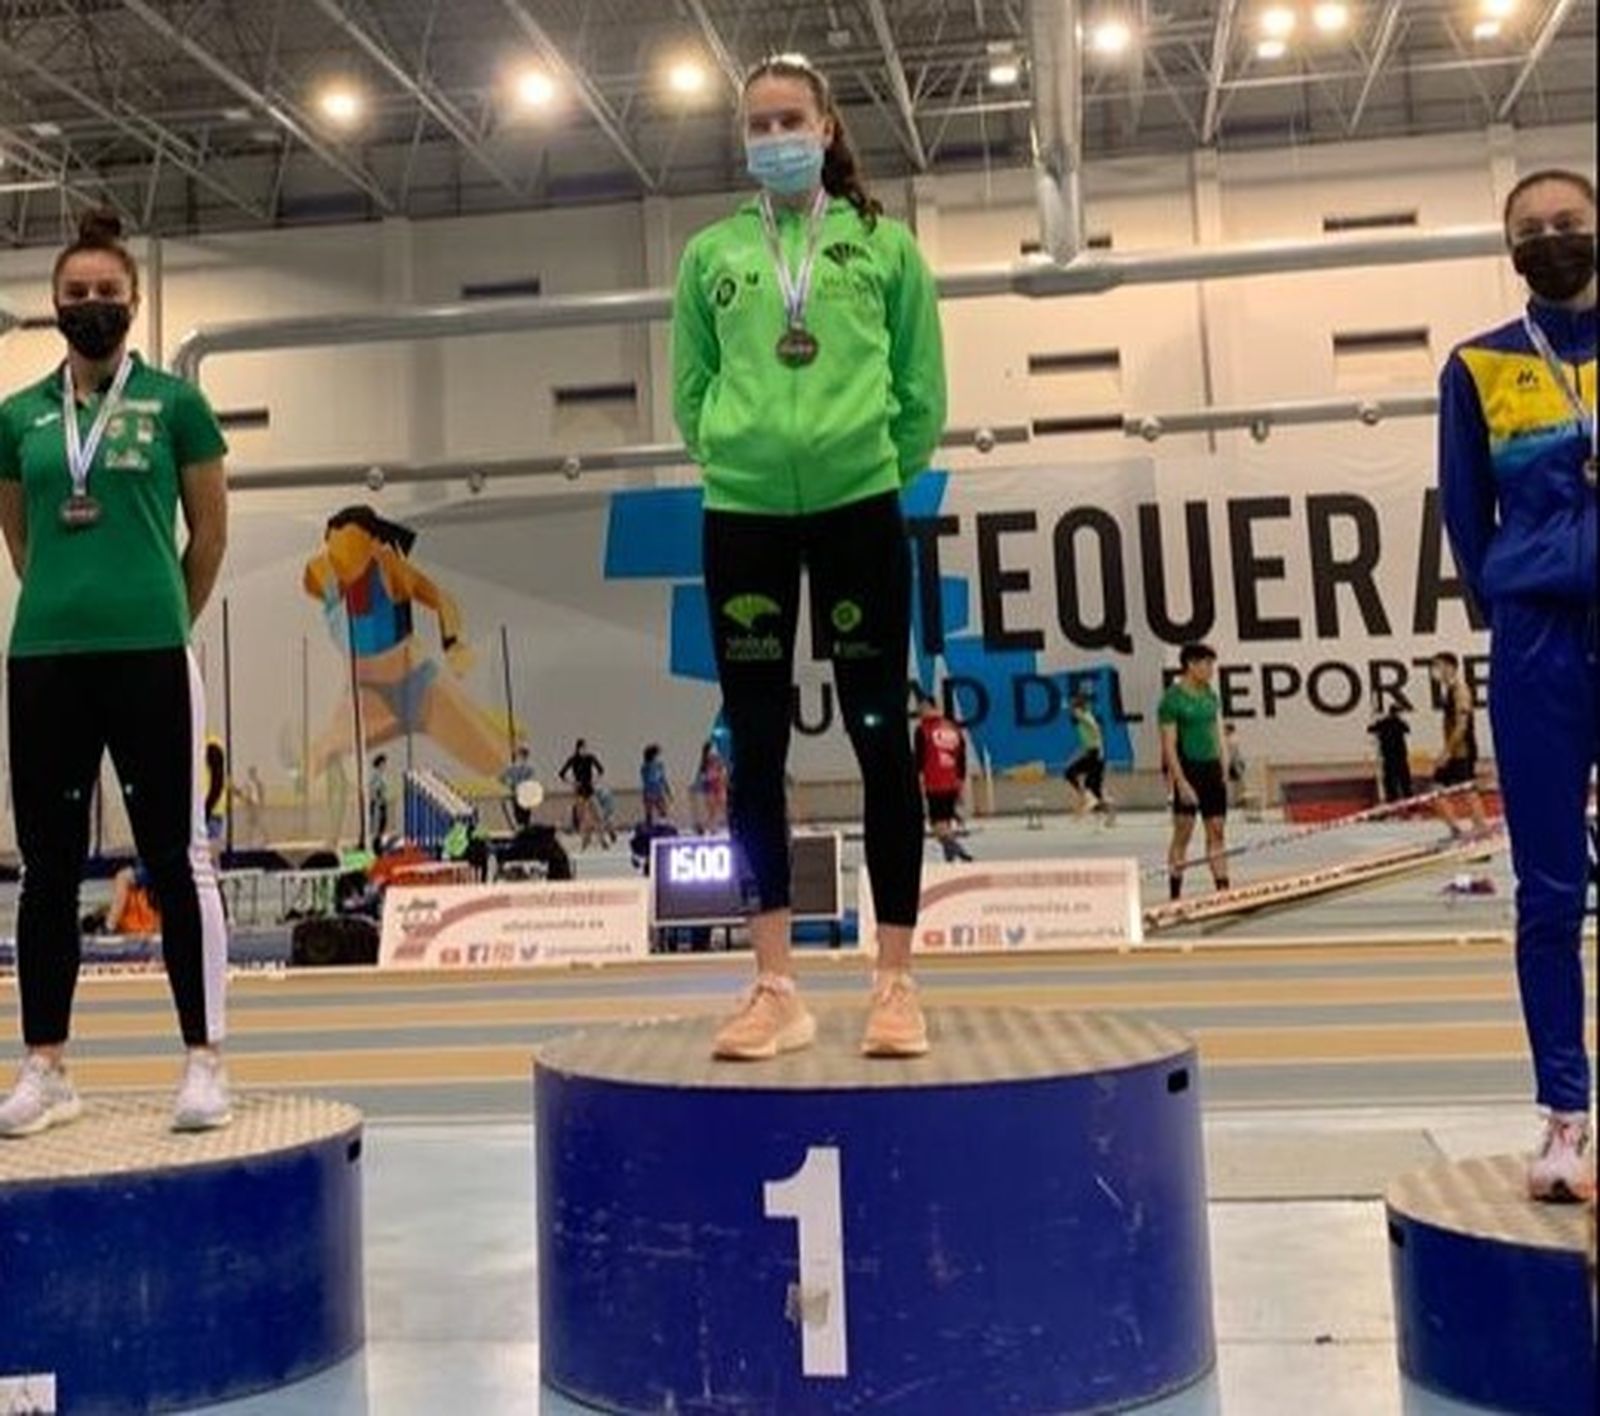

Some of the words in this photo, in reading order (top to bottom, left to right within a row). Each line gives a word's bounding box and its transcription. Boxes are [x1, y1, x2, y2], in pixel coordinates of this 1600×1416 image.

[810, 488, 1491, 660] TEQUERA
[1163, 655, 1491, 719] EPORTE
[763, 1146, 848, 1376] 1
